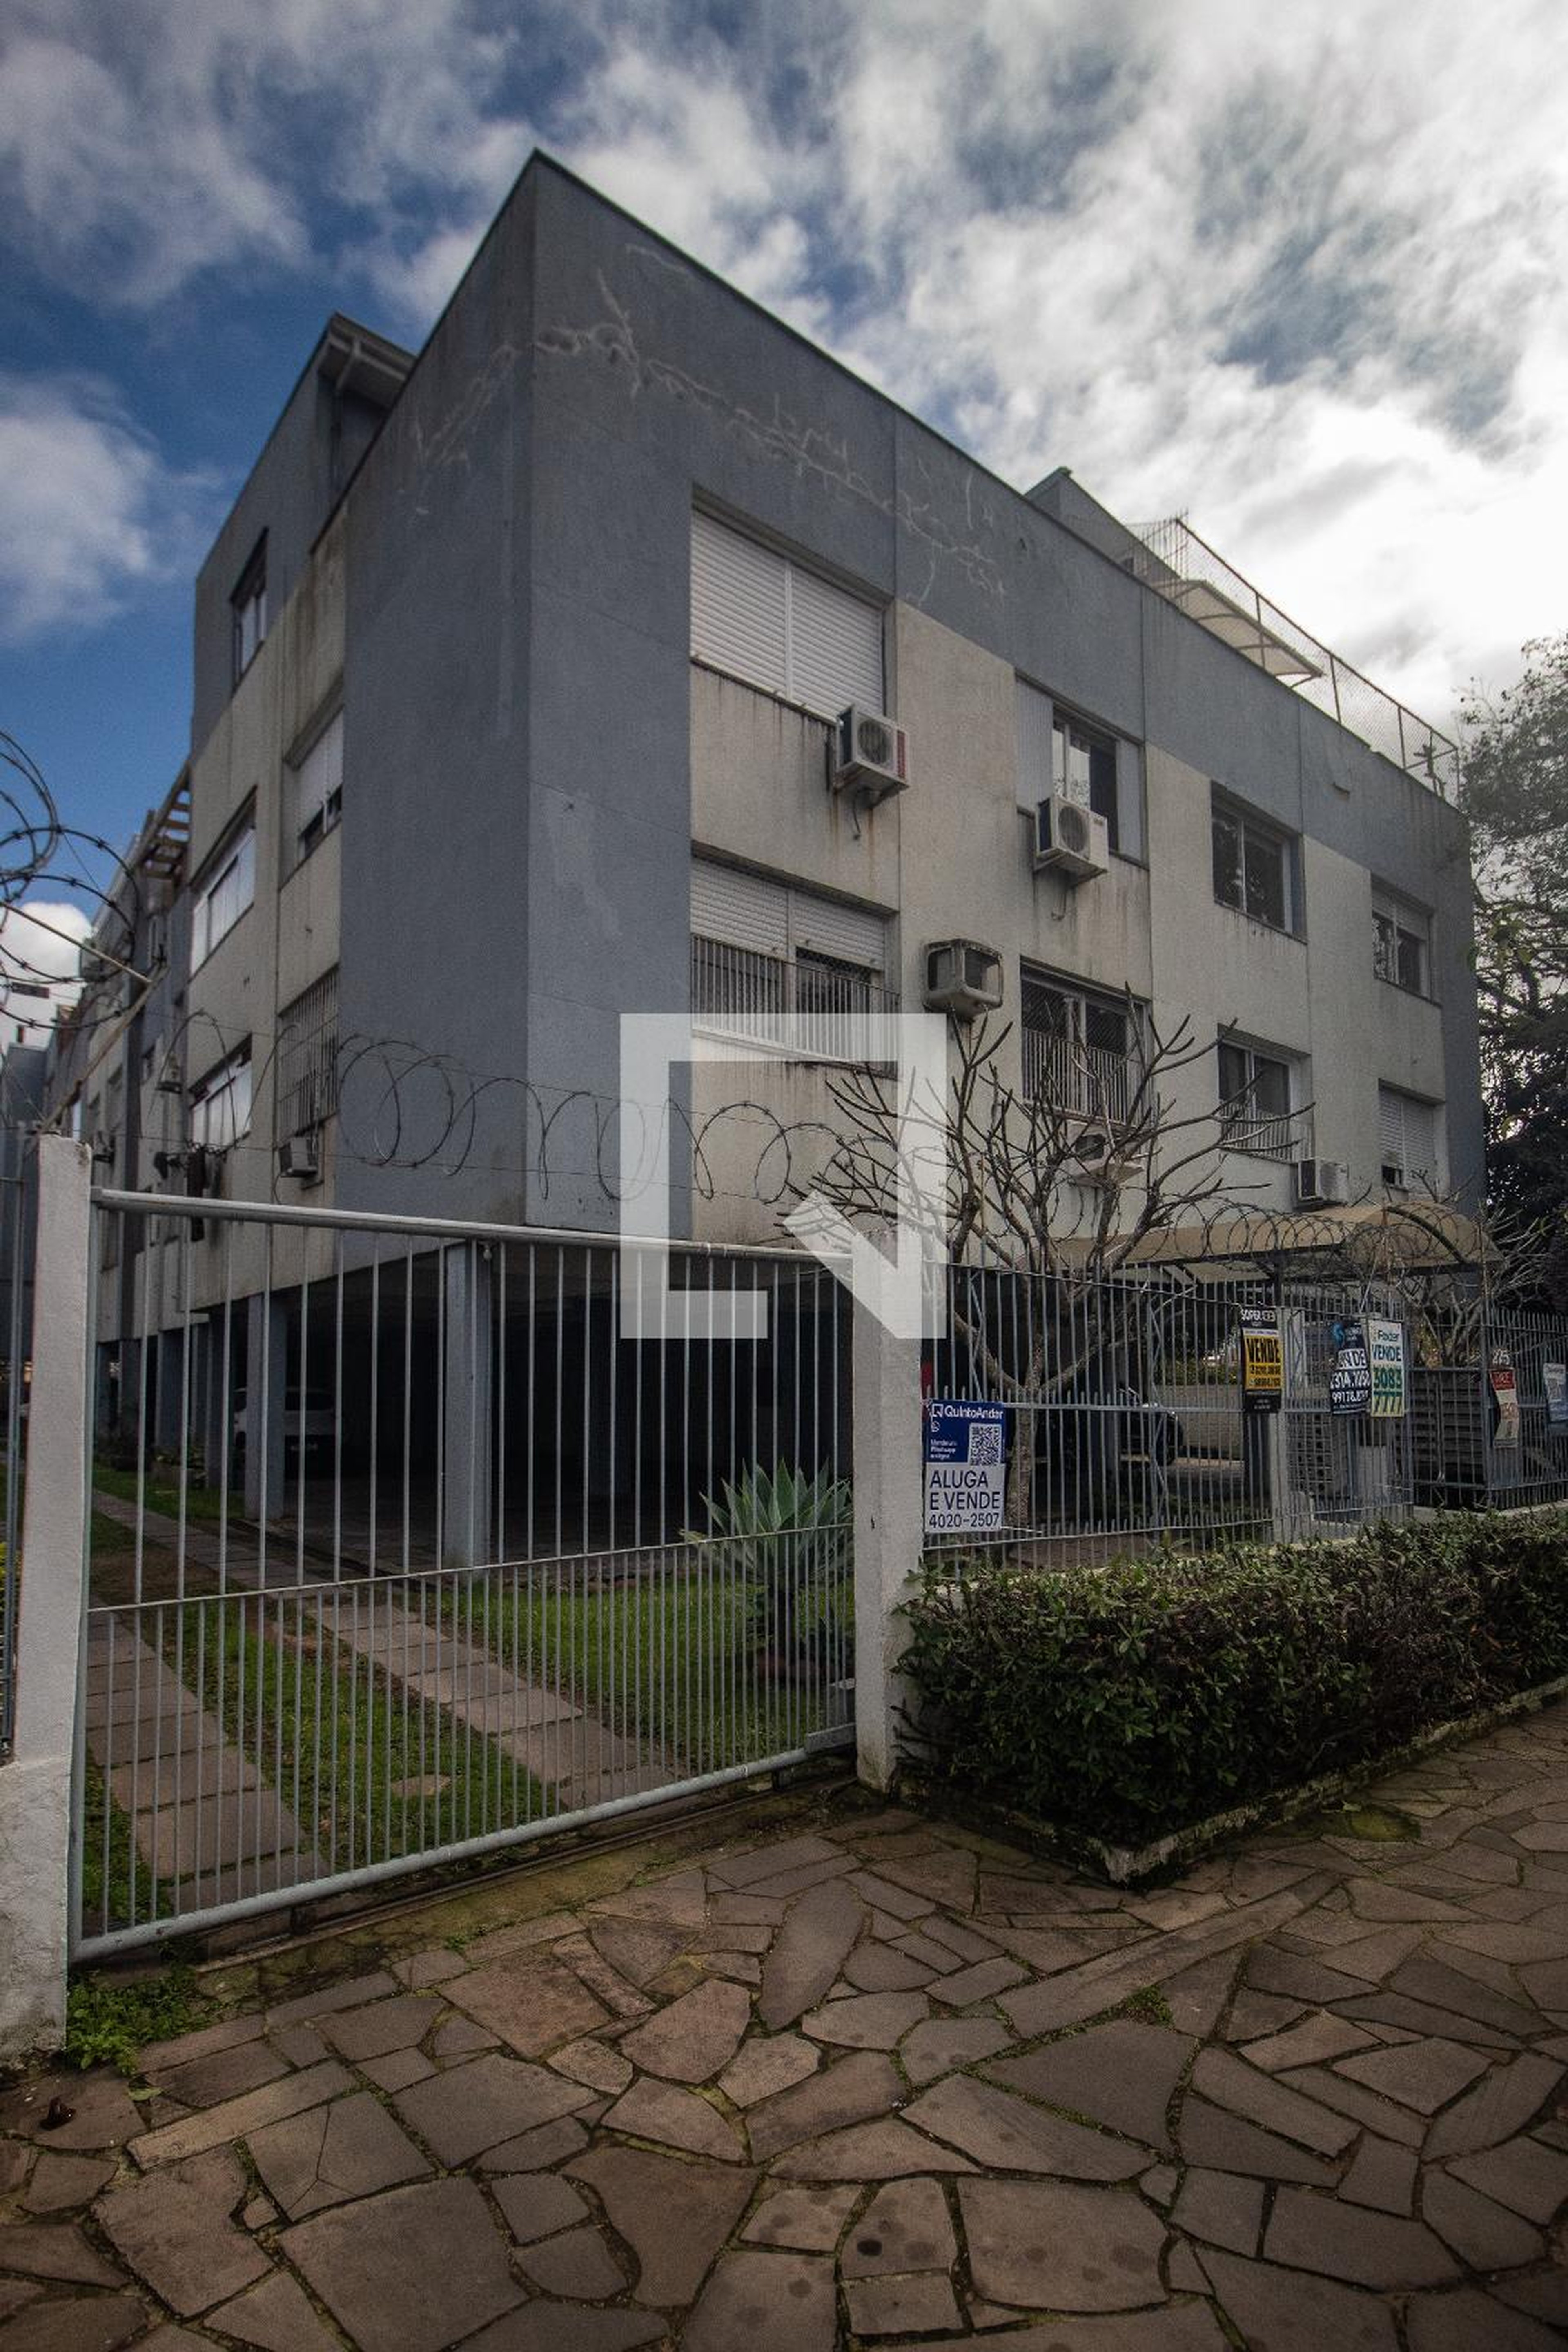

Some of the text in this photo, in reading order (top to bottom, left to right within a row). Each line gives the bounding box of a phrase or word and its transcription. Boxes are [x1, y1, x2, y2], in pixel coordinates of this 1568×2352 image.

[1247, 1337, 1281, 1363] VENDE
[1372, 1344, 1402, 1362] VENDE
[1373, 1367, 1402, 1389] 3083
[944, 1405, 1003, 1420] QuintoAndar
[930, 1470, 988, 1488] ALUGA
[930, 1491, 1000, 1510] E VENDE
[929, 1512, 999, 1528] 4020-2507
